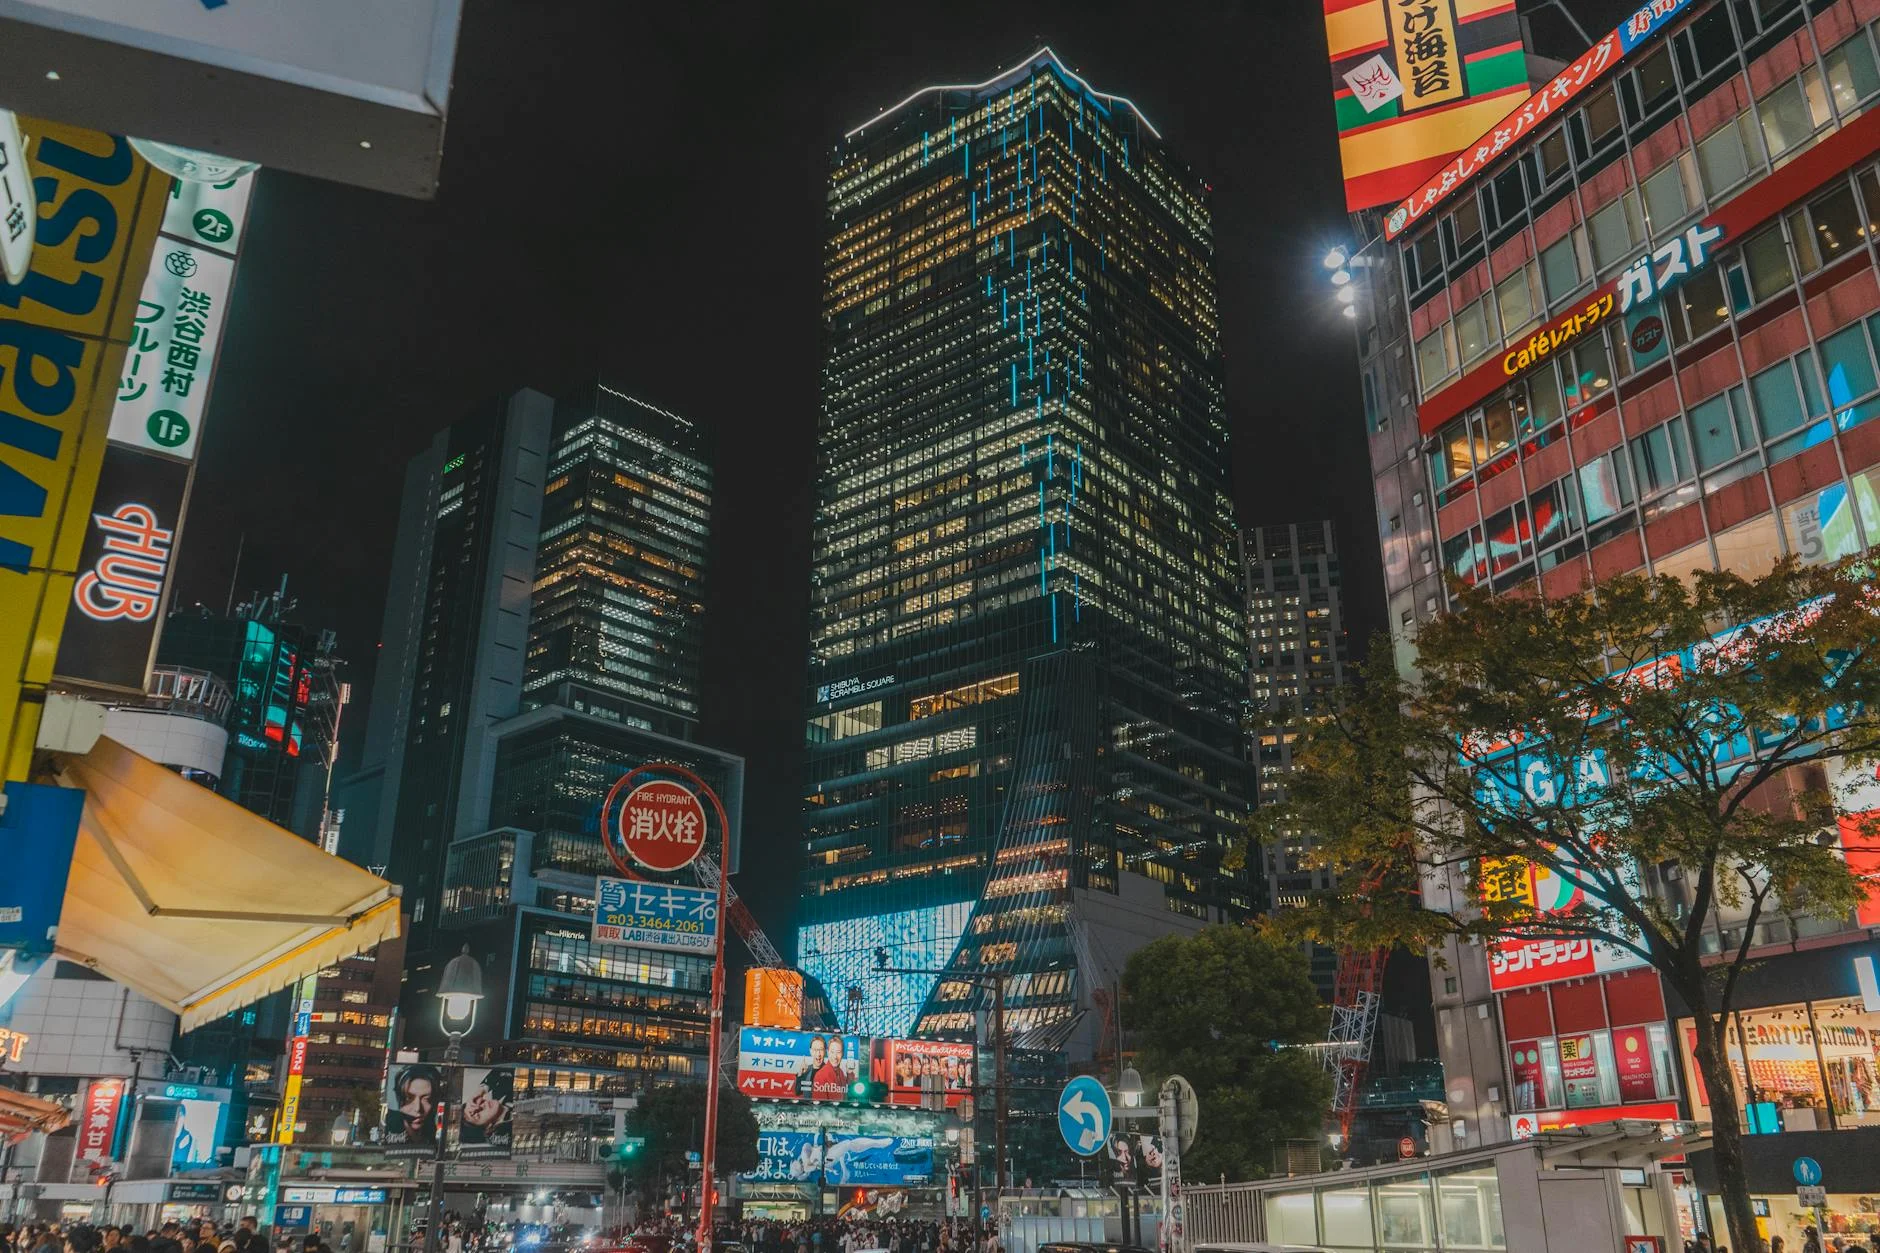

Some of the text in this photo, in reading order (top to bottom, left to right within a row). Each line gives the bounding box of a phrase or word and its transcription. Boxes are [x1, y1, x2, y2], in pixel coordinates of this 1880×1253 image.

[1408, 34, 1615, 218] しゃぶしゃぶバイキング
[199, 214, 228, 237] 2F
[1617, 224, 1720, 313] ガスト
[160, 287, 211, 397] 渋谷西村
[158, 416, 184, 441] 1F
[74, 502, 174, 622] HUB
[830, 675, 896, 700] SCRAMBLE SQUARE
[831, 677, 860, 692] SHIBUYA
[637, 792, 693, 806] FIRE HYDRANT
[629, 806, 699, 844] 消火栓
[630, 885, 716, 921] セキネ
[559, 929, 586, 940] Hikarie
[597, 926, 620, 940] 買取
[617, 914, 705, 933] 03-3464-2061
[1493, 938, 1589, 976] サンドラッグ
[1818, 1023, 1868, 1047] ATHING
[1562, 1041, 1577, 1059] 薬
[1564, 1066, 1595, 1078] サンドラッグ
